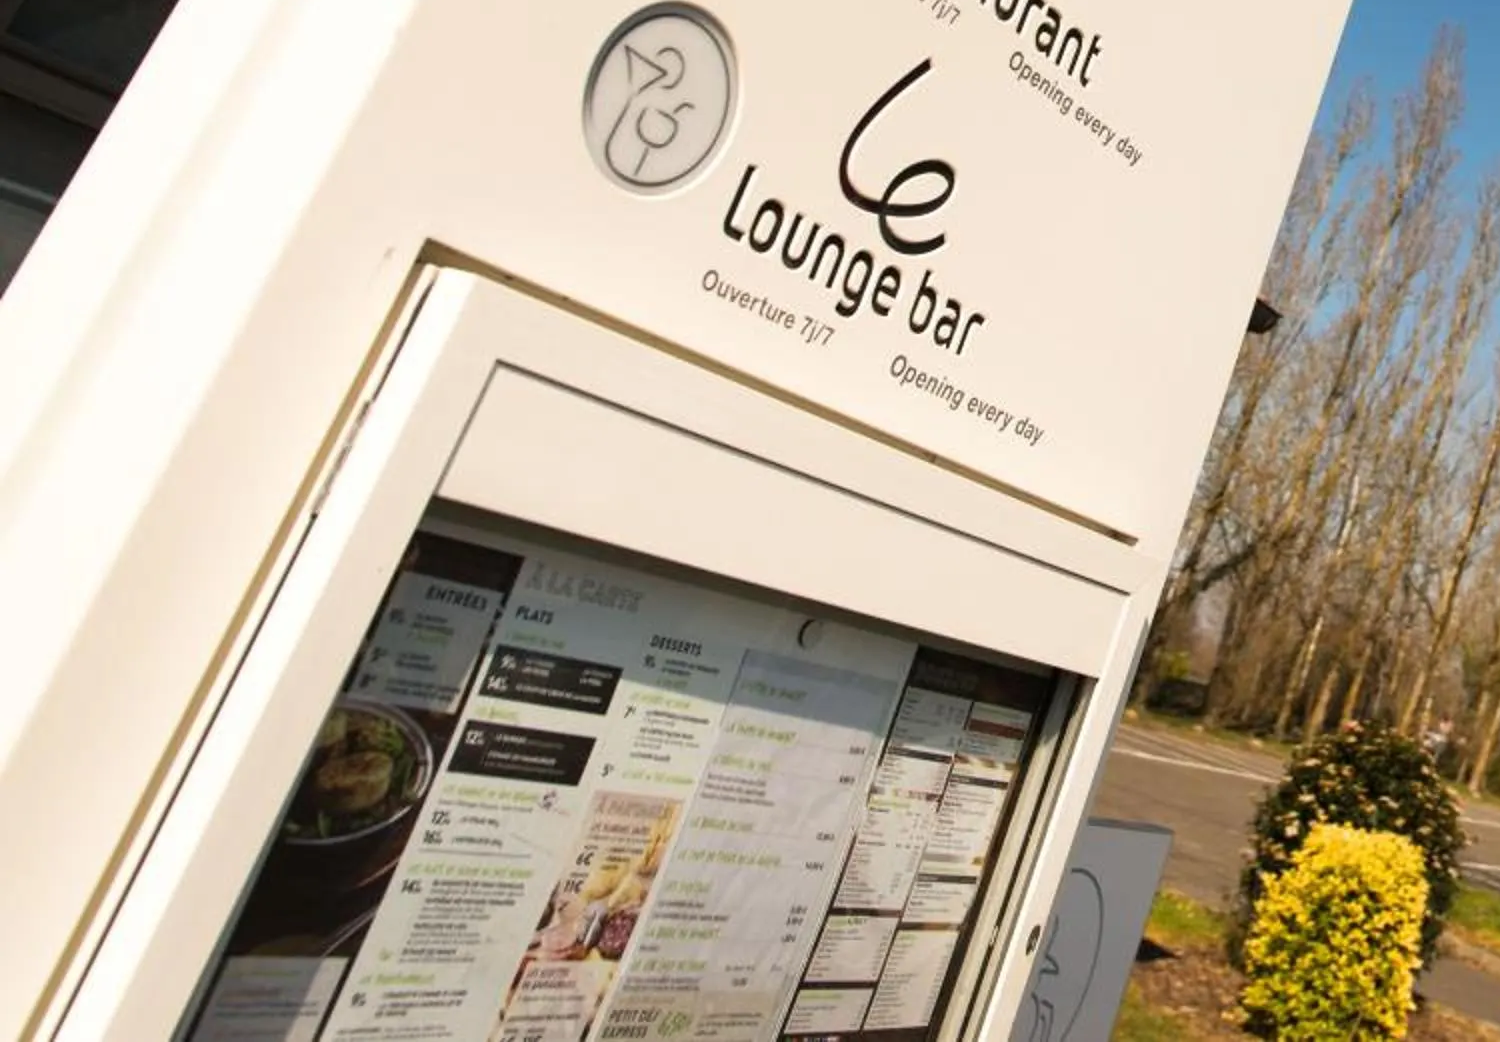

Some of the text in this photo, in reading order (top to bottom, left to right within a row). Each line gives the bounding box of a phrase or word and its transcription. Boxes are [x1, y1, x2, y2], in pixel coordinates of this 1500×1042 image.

[1008, 51, 1144, 166] Opening every day
[701, 268, 836, 349] Ouverture 7j/7
[722, 163, 986, 356] Lounge bar
[889, 353, 1047, 447] Opening every day
